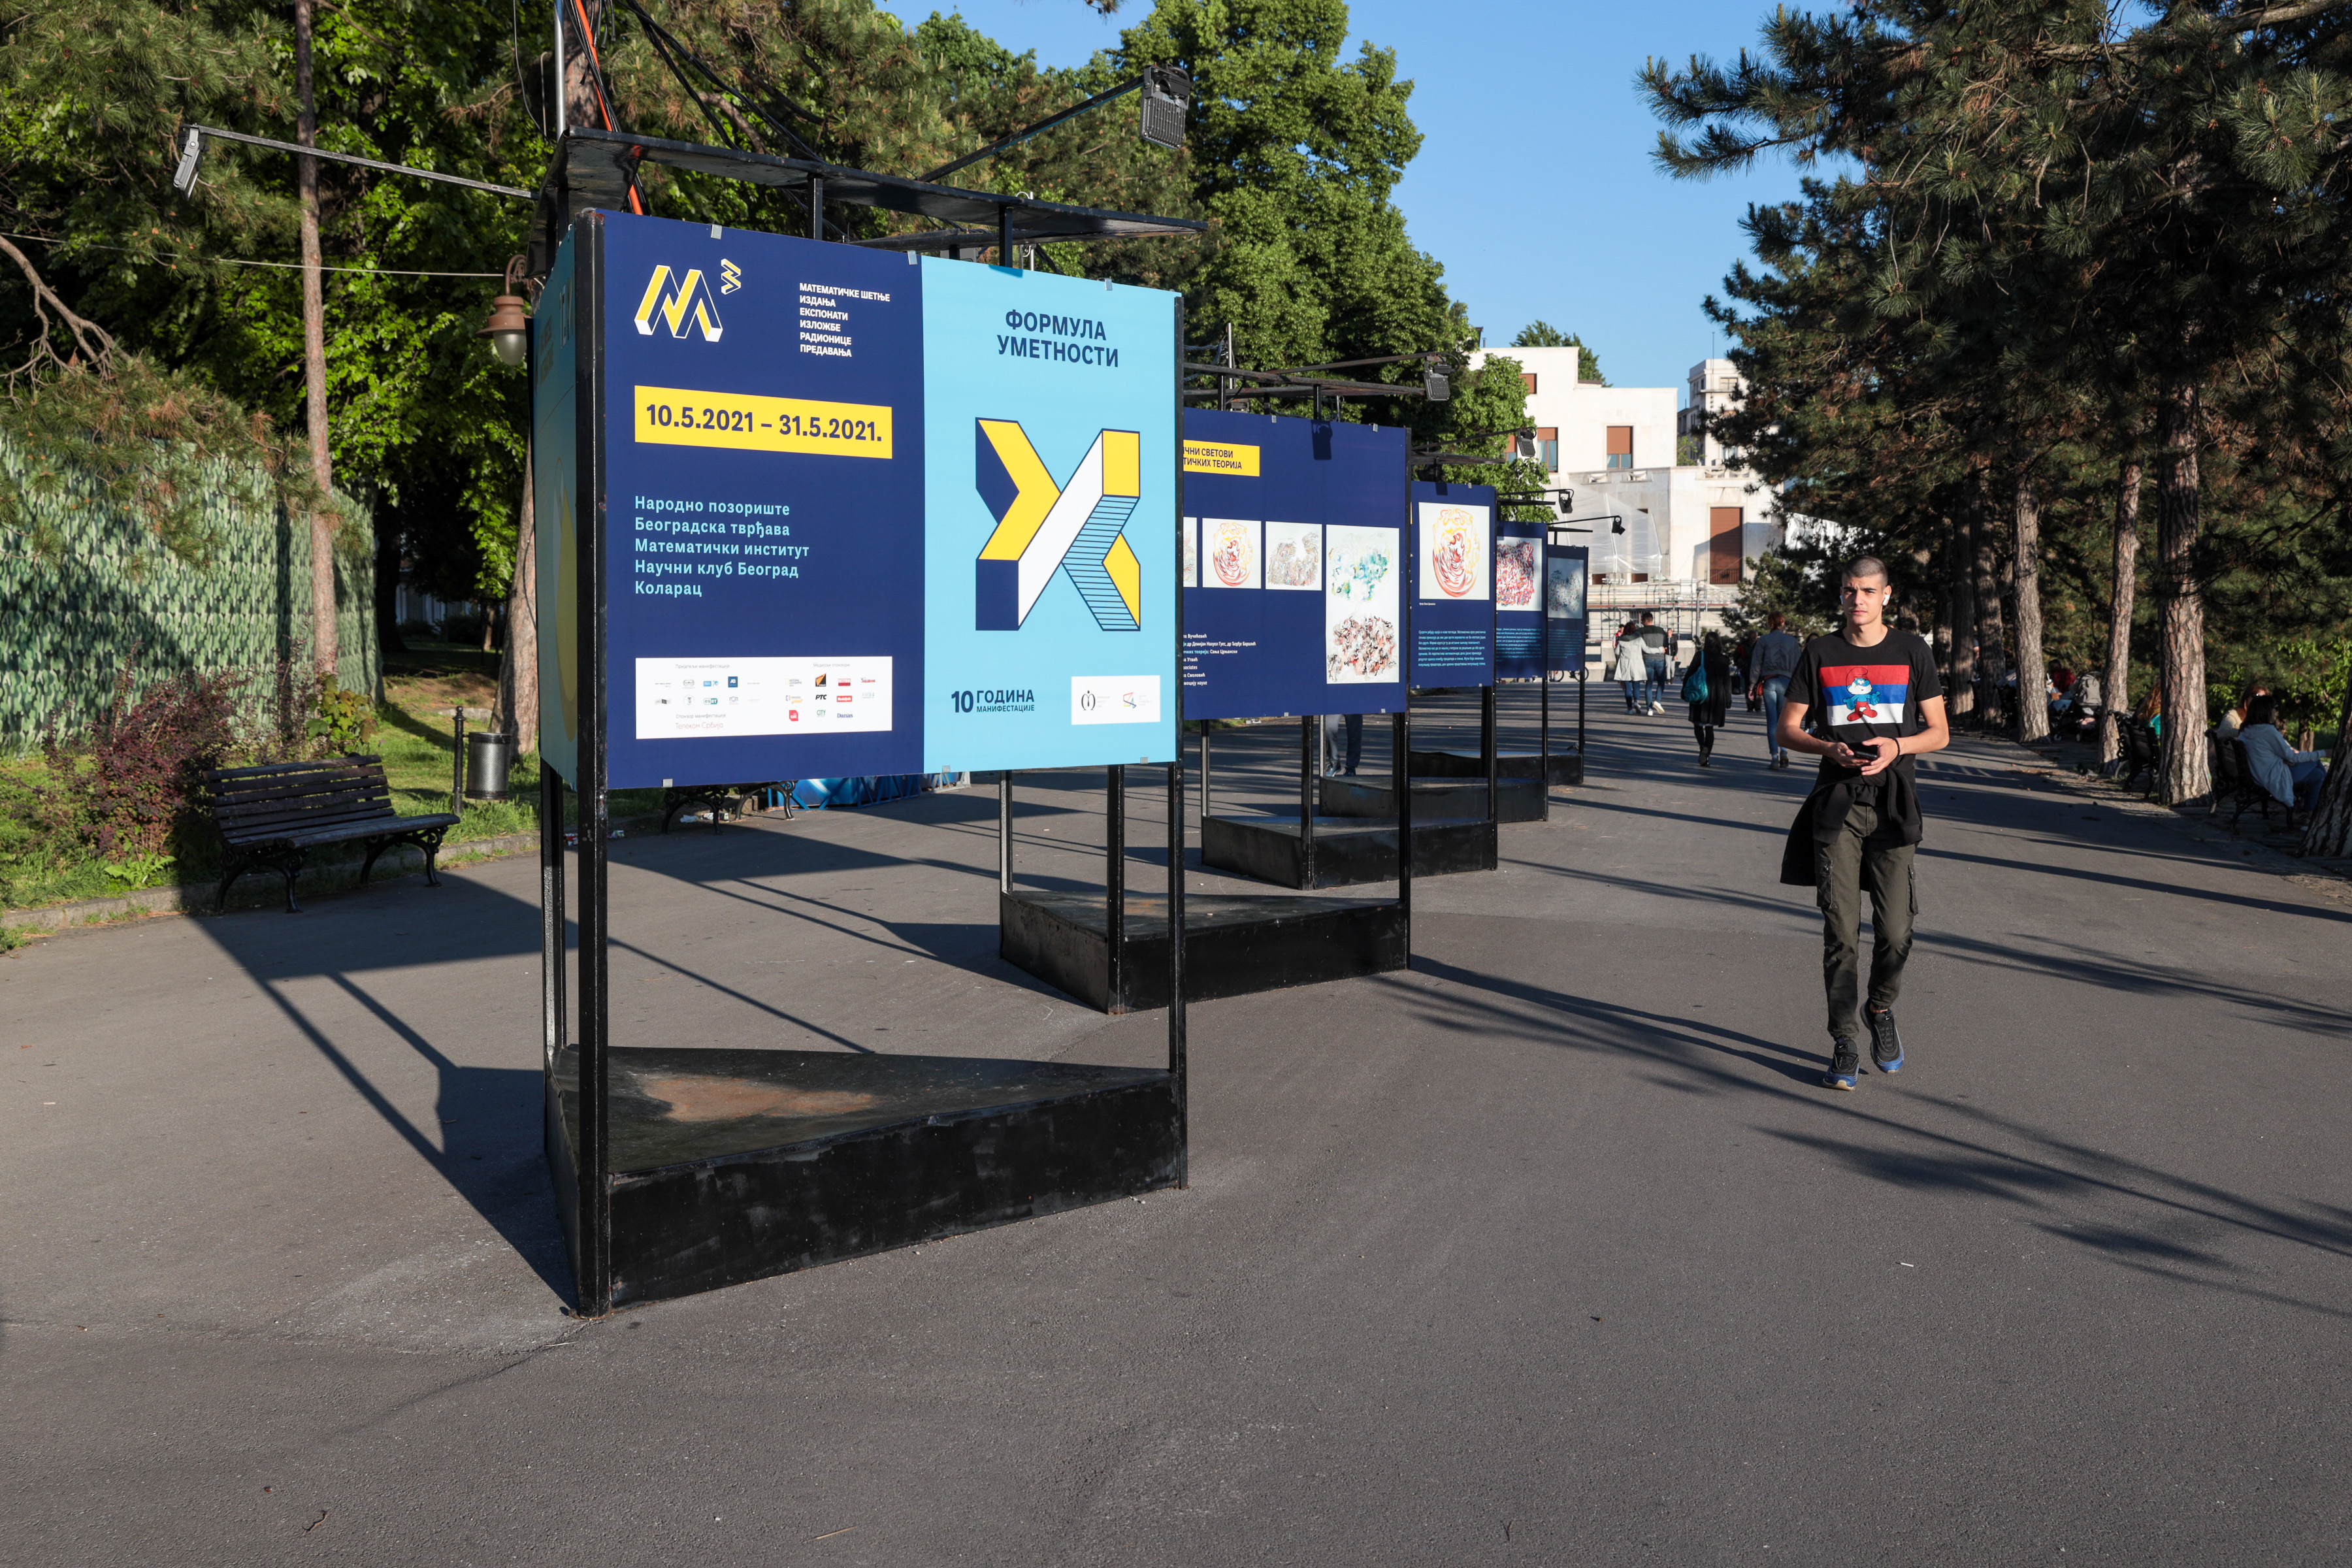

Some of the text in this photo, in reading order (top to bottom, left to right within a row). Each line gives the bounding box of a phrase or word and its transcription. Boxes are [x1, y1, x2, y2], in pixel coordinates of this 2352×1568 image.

[800, 283, 890, 302] МАТЕМАТИЧКЕ ШЕТЊЕ
[800, 295, 836, 307] ИЗДАЊА
[800, 308, 848, 321] ЕКСПОНАТИ
[800, 319, 841, 332] ИЗЛОЖБЕ
[1005, 308, 1107, 341] ФОРМУЛА
[800, 332, 852, 346] РАДИОНИЦЕ
[800, 345, 852, 357] ПРЕДАВАЊА
[997, 335, 1119, 367] УМЕТНОСТИ
[646, 404, 753, 431] 10.5.2021
[779, 415, 882, 441] 31.5.2021.
[1201, 448, 1233, 458] СВЕТОВИ
[1212, 459, 1242, 470] ТЕОРИЈА
[634, 496, 790, 516] Народно позориште
[634, 517, 790, 538] Београдска тврђава
[634, 538, 809, 559] Математички институт
[634, 559, 798, 578] Научни клуб Београд
[634, 581, 702, 598] Коларац
[951, 689, 1034, 713] 10 ГОДИНА
